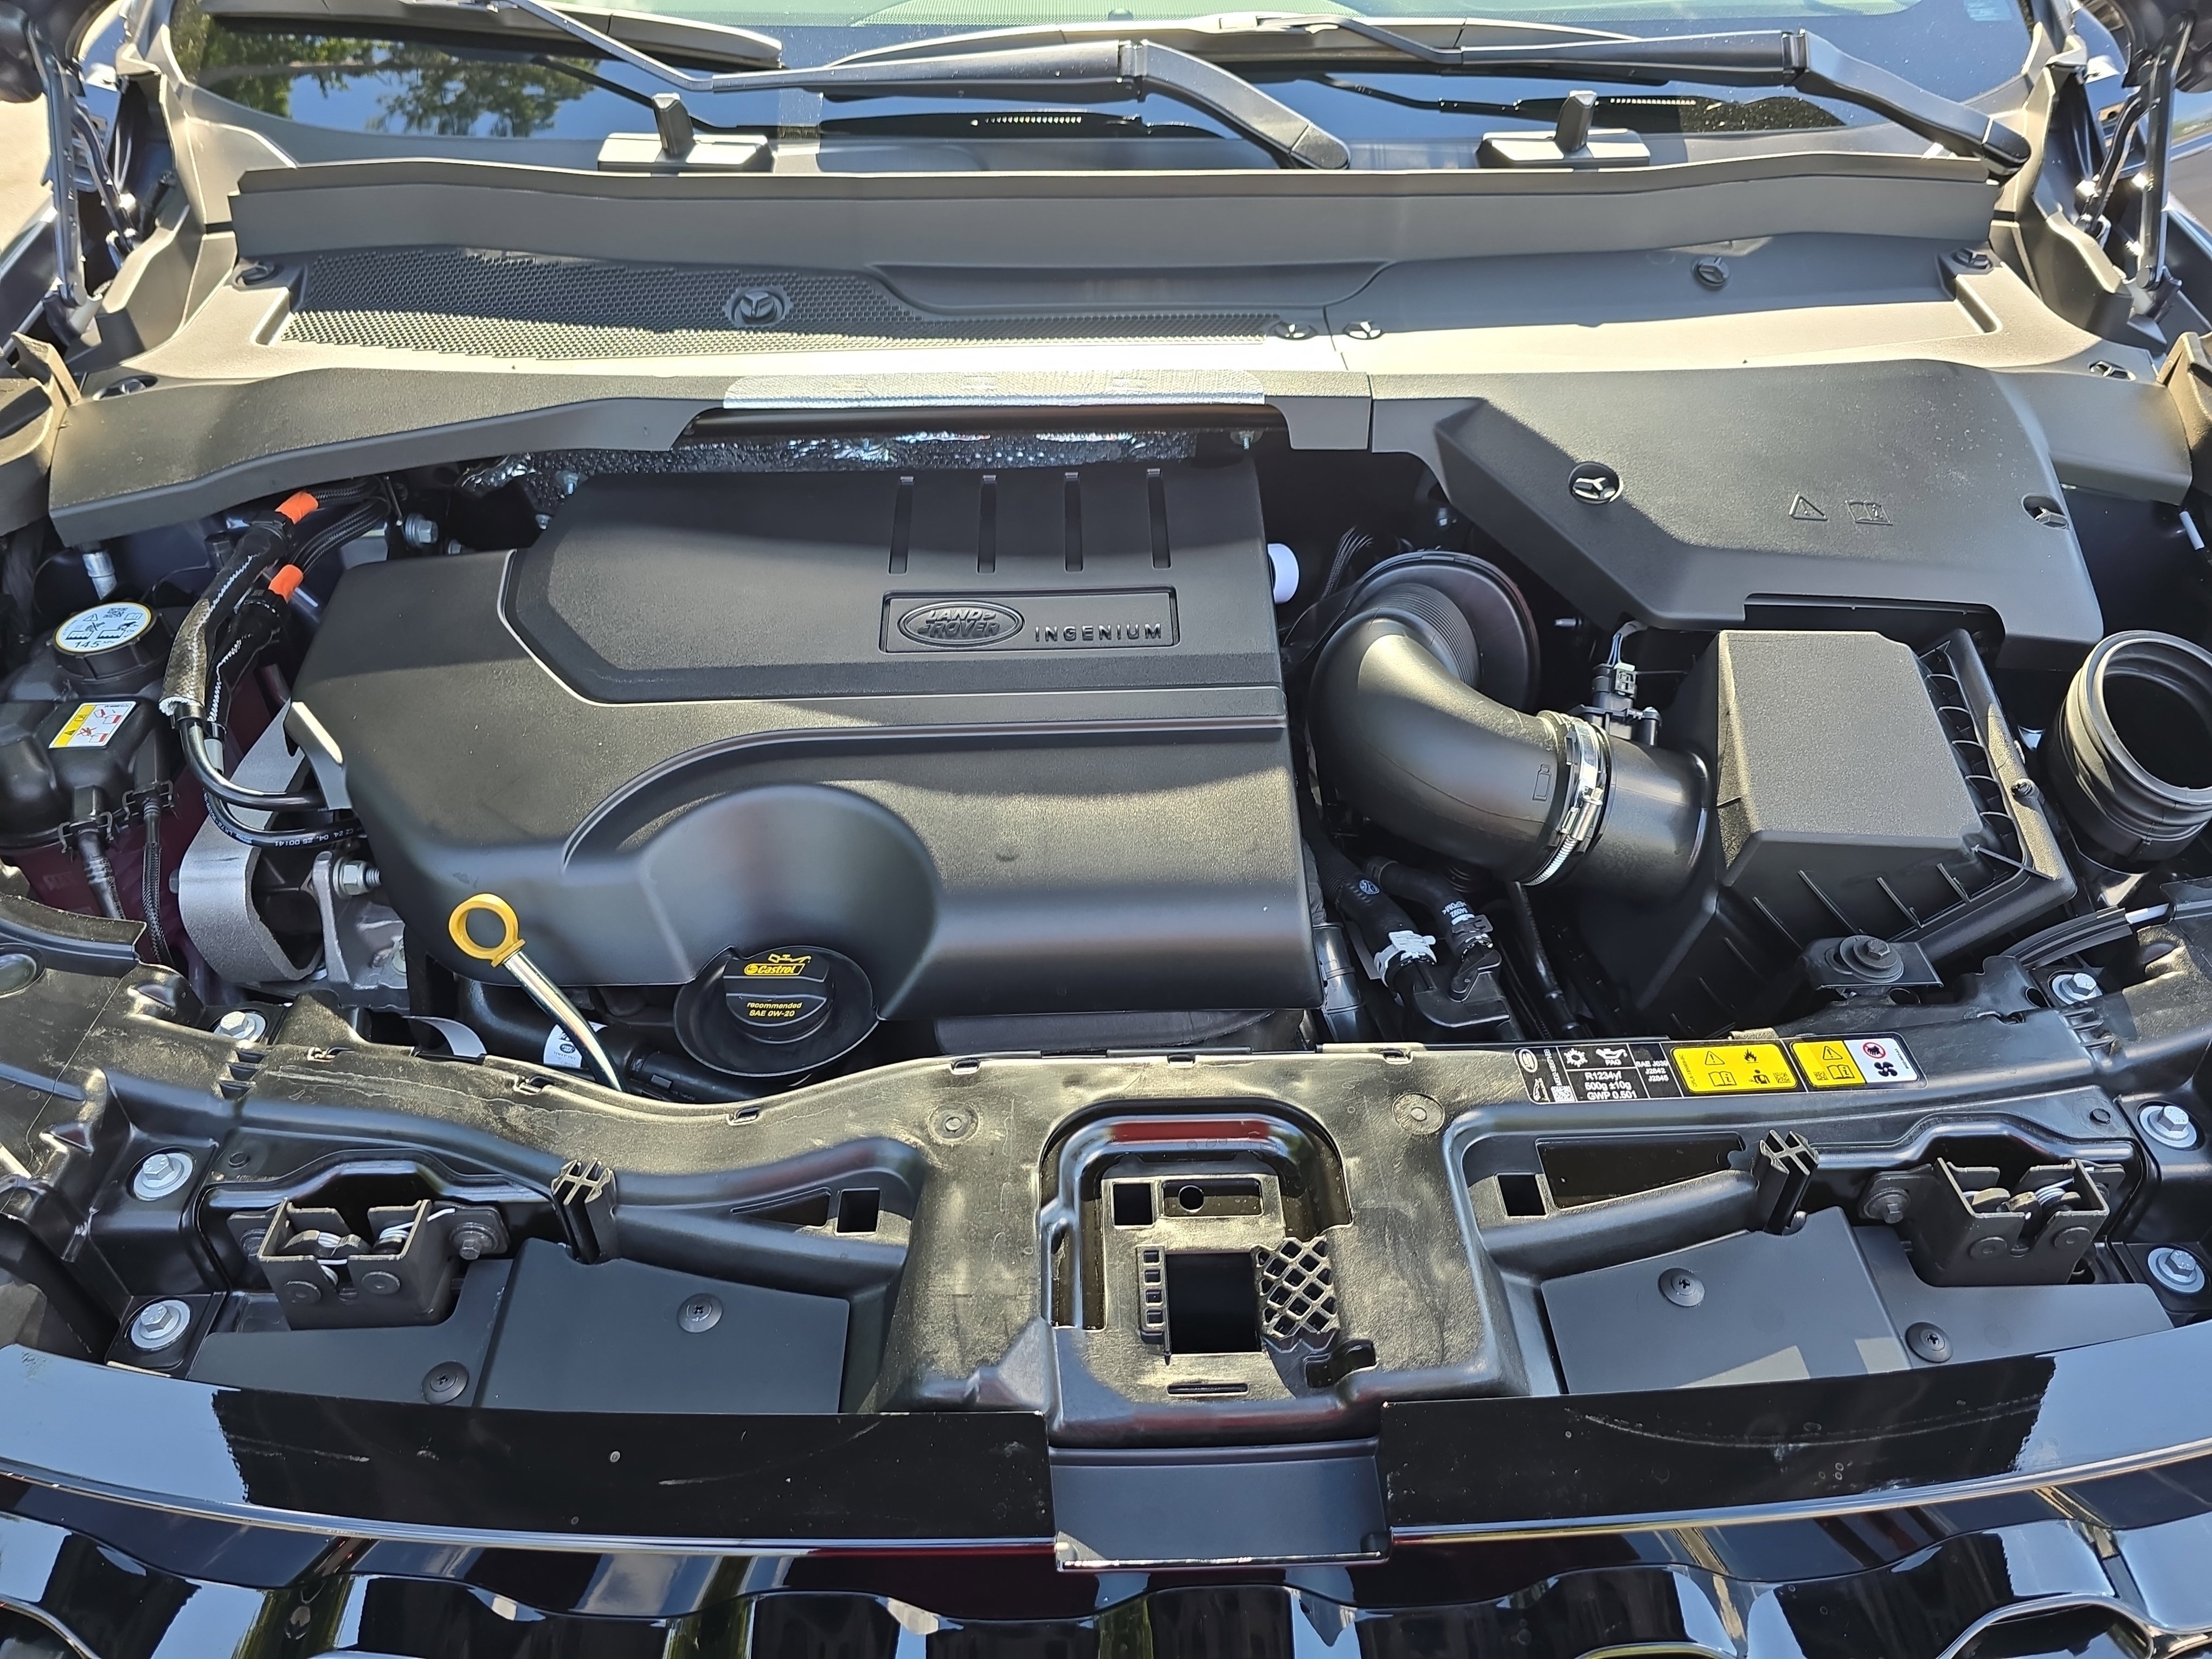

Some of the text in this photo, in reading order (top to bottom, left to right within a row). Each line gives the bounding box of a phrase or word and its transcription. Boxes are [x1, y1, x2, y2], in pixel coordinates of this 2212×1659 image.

[925, 608, 996, 623] LAND
[917, 622, 1000, 637] ROVER
[1035, 623, 1162, 642] INGENIUM
[757, 965, 796, 974] Castrol
[1584, 1070, 1622, 1081] R1234yf
[1584, 1082, 1609, 1091] 500g
[1587, 1090, 1637, 1101] GWP 0.501
